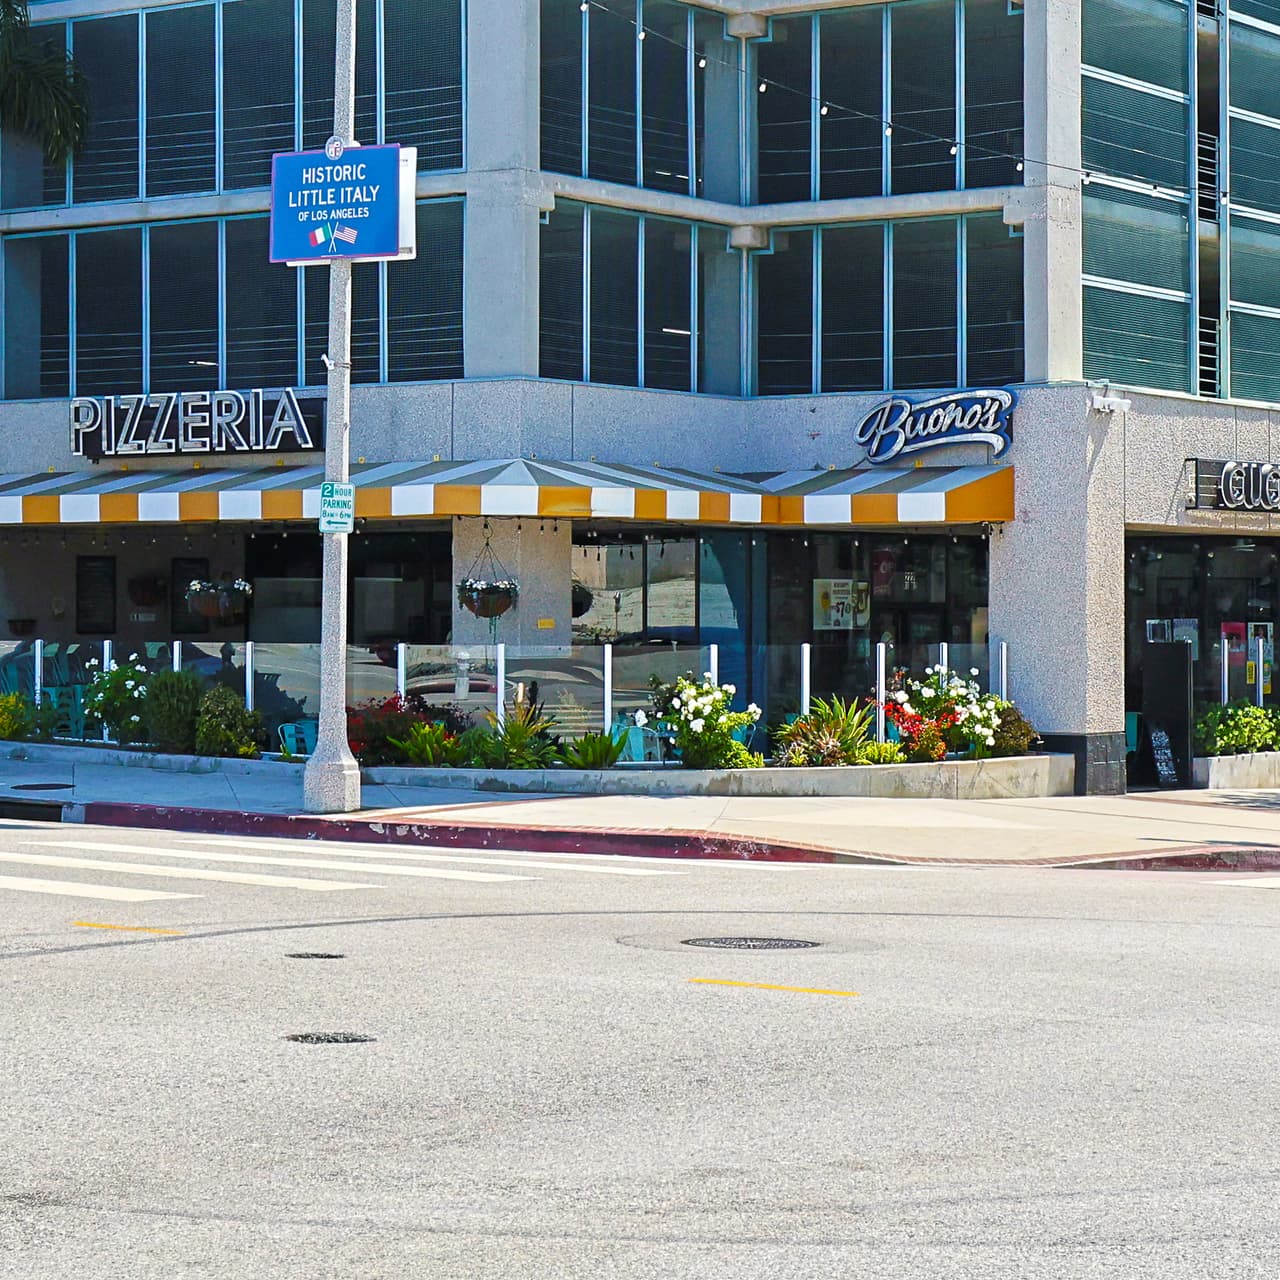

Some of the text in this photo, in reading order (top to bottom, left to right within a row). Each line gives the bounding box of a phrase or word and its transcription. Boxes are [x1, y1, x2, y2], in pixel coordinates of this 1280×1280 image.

[302, 164, 366, 184] HISTORIC
[289, 185, 380, 207] LITTLE ITALY
[298, 207, 369, 221] OF LOS ANGELES
[70, 387, 314, 456] PIZZERIA
[855, 398, 1002, 463] Buono's
[324, 485, 352, 496] 2 HOUR
[323, 499, 352, 509] PARKING
